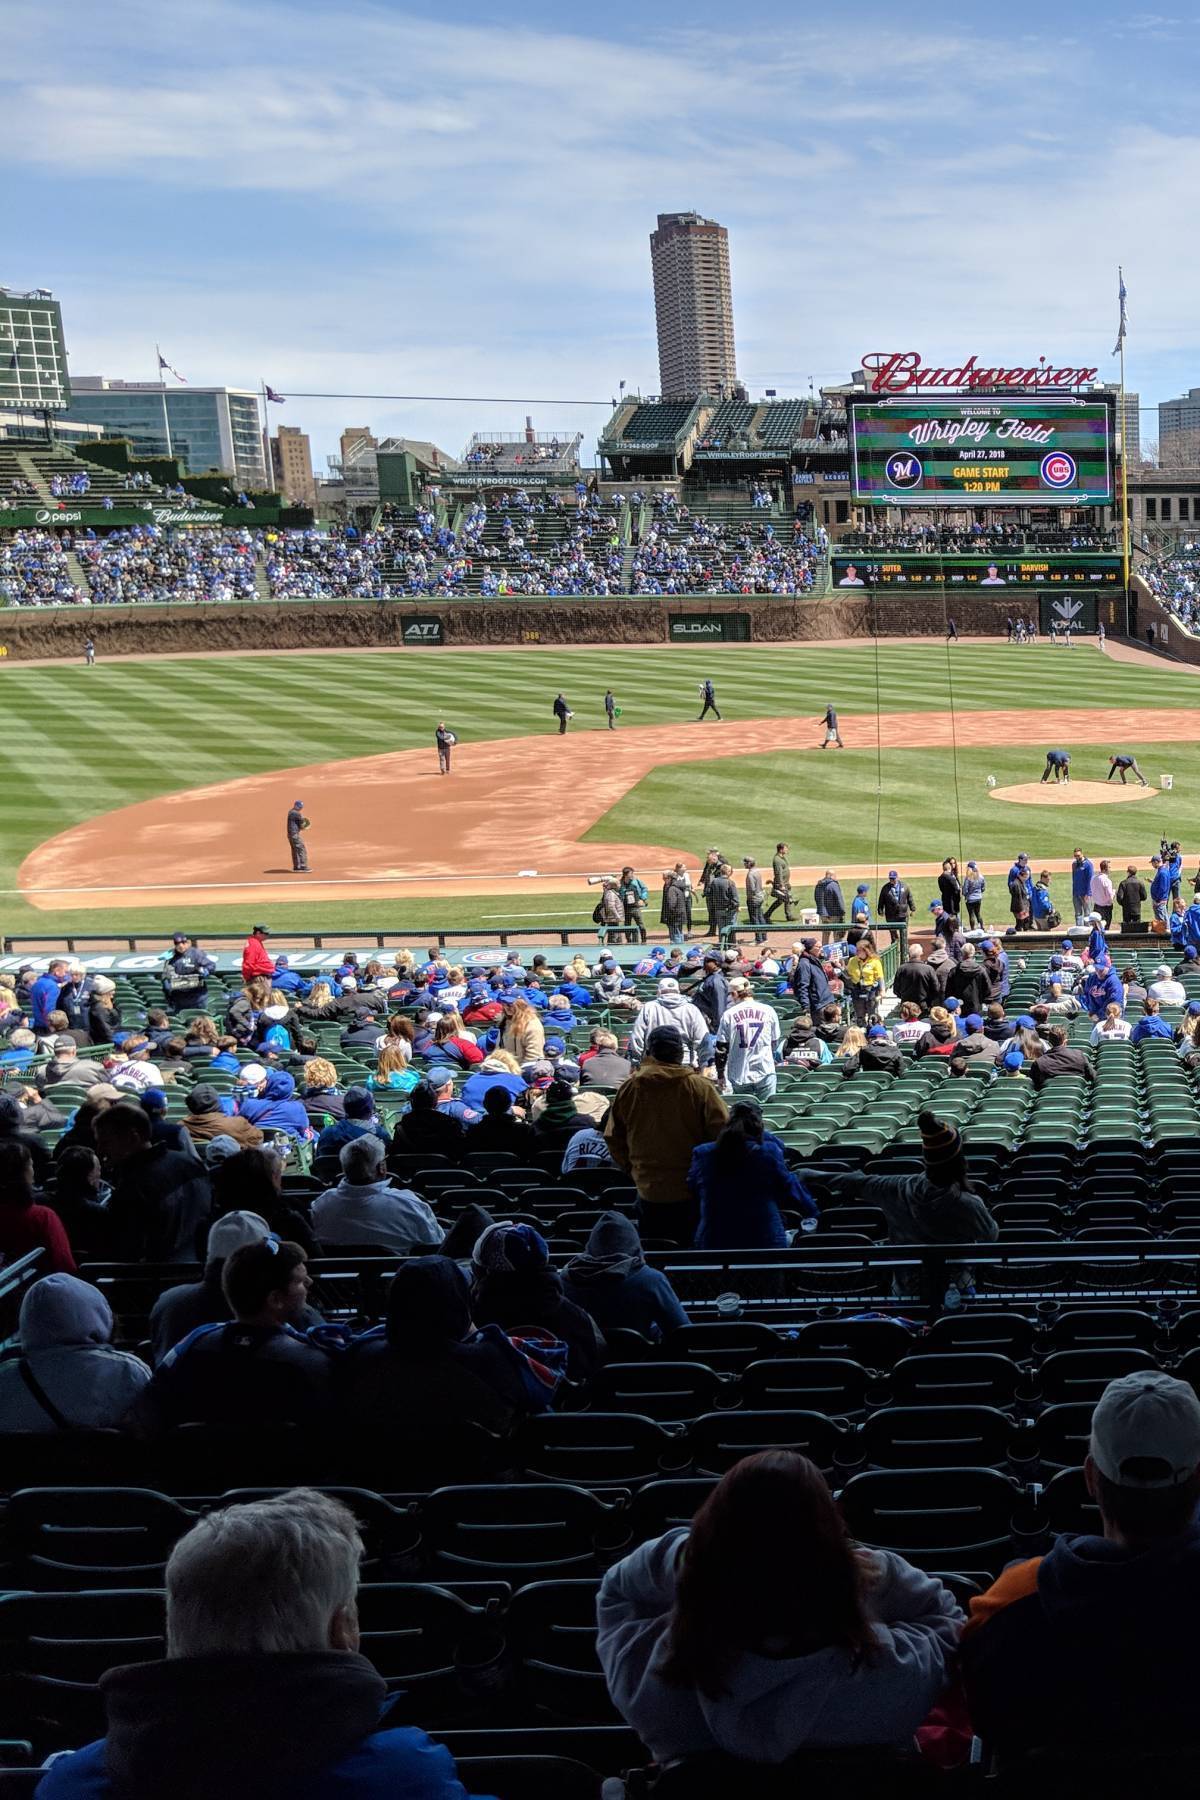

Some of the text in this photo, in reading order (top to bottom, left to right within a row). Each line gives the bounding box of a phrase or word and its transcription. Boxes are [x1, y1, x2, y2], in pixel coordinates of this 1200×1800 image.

[861, 351, 1098, 392] Budweiser
[909, 418, 1056, 445] Wrigley Field
[959, 450, 1005, 460] April 27, 2018
[953, 467, 1010, 478] GAME START
[452, 477, 548, 485] WRIGLEYROOFTOPS.COM
[963, 481, 1001, 492] 1:20 PM
[51, 511, 82, 522] pepsi
[152, 508, 223, 523] Budweiser
[405, 623, 440, 635] ATI
[672, 623, 722, 633] SLOAN
[732, 1011, 766, 1023] BRYANT
[735, 1022, 765, 1049] 17
